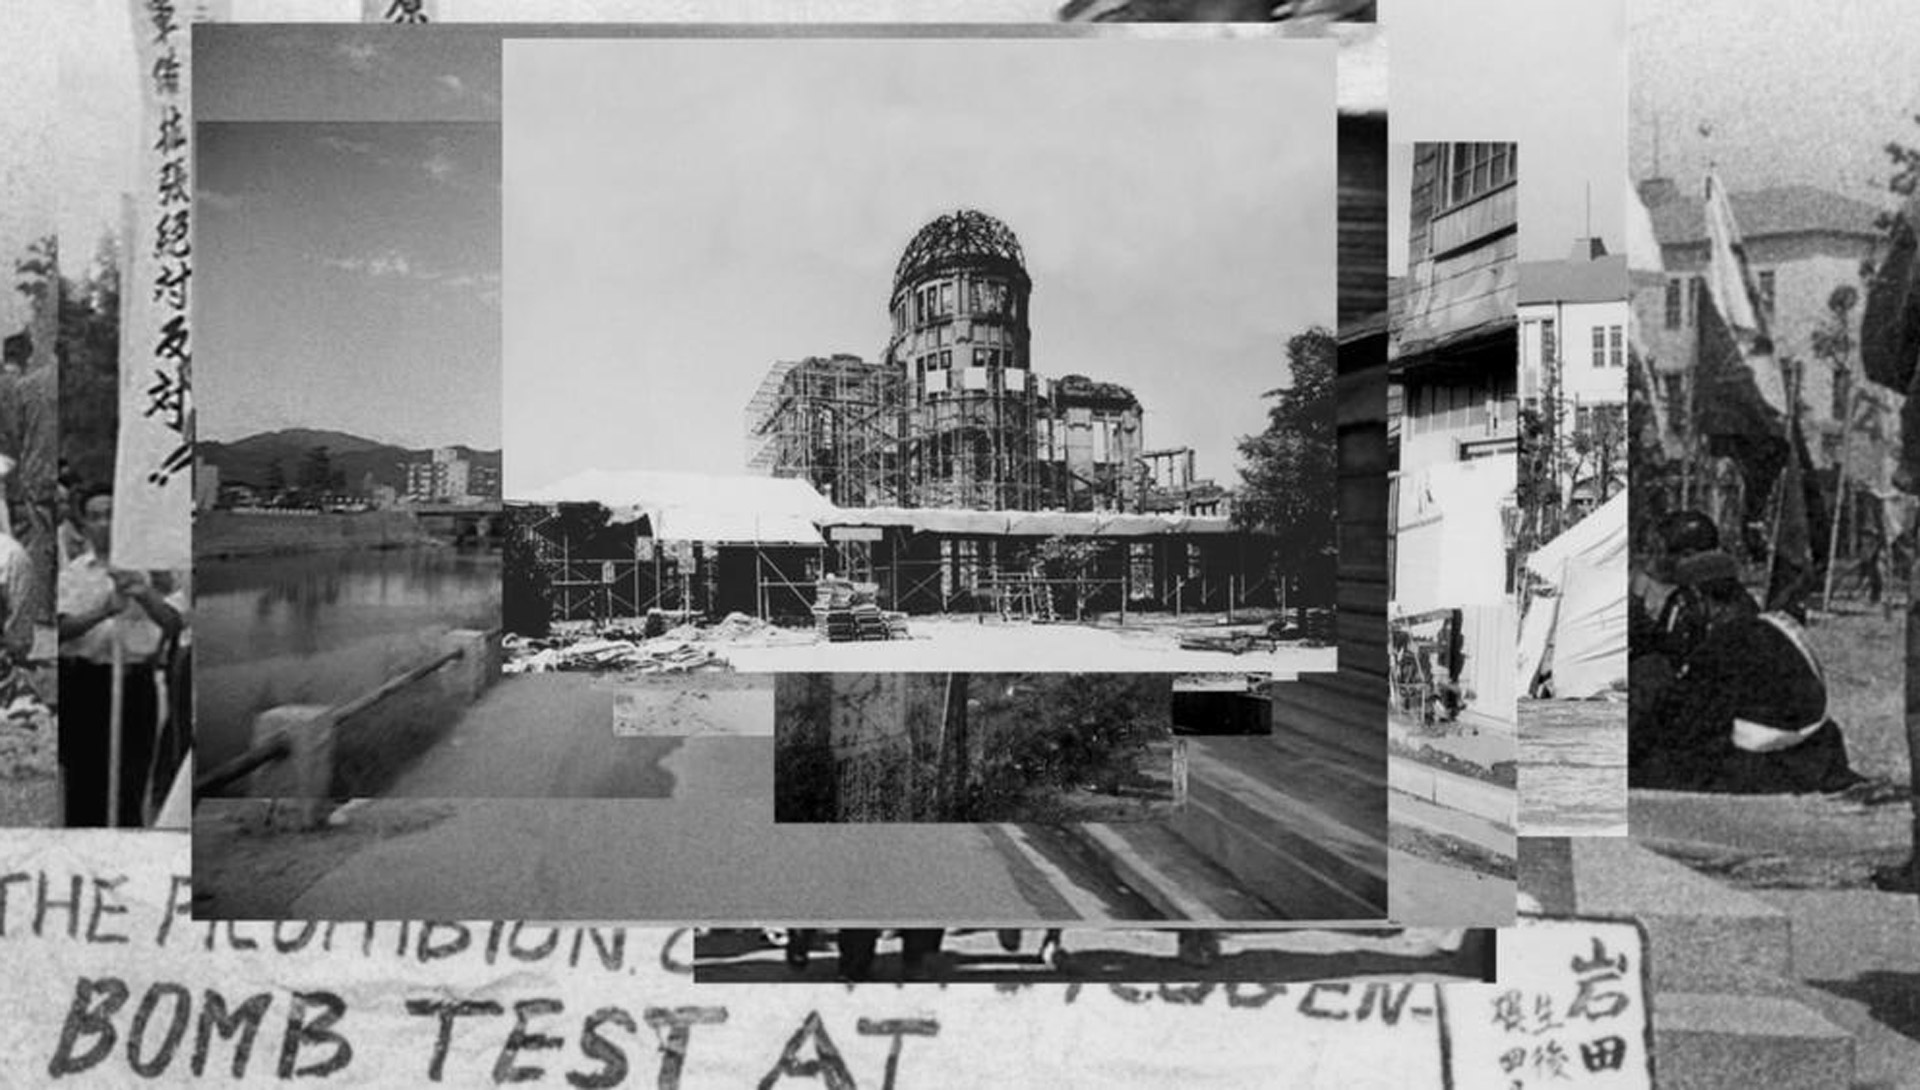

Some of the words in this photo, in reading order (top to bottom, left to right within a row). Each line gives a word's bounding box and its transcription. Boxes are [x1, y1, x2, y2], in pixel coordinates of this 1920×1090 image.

[0, 870, 129, 942] THE
[48, 976, 353, 1080] BOMB
[405, 997, 729, 1090] TEST
[757, 1009, 941, 1090] AT
[1566, 936, 1630, 1074] 岩田
